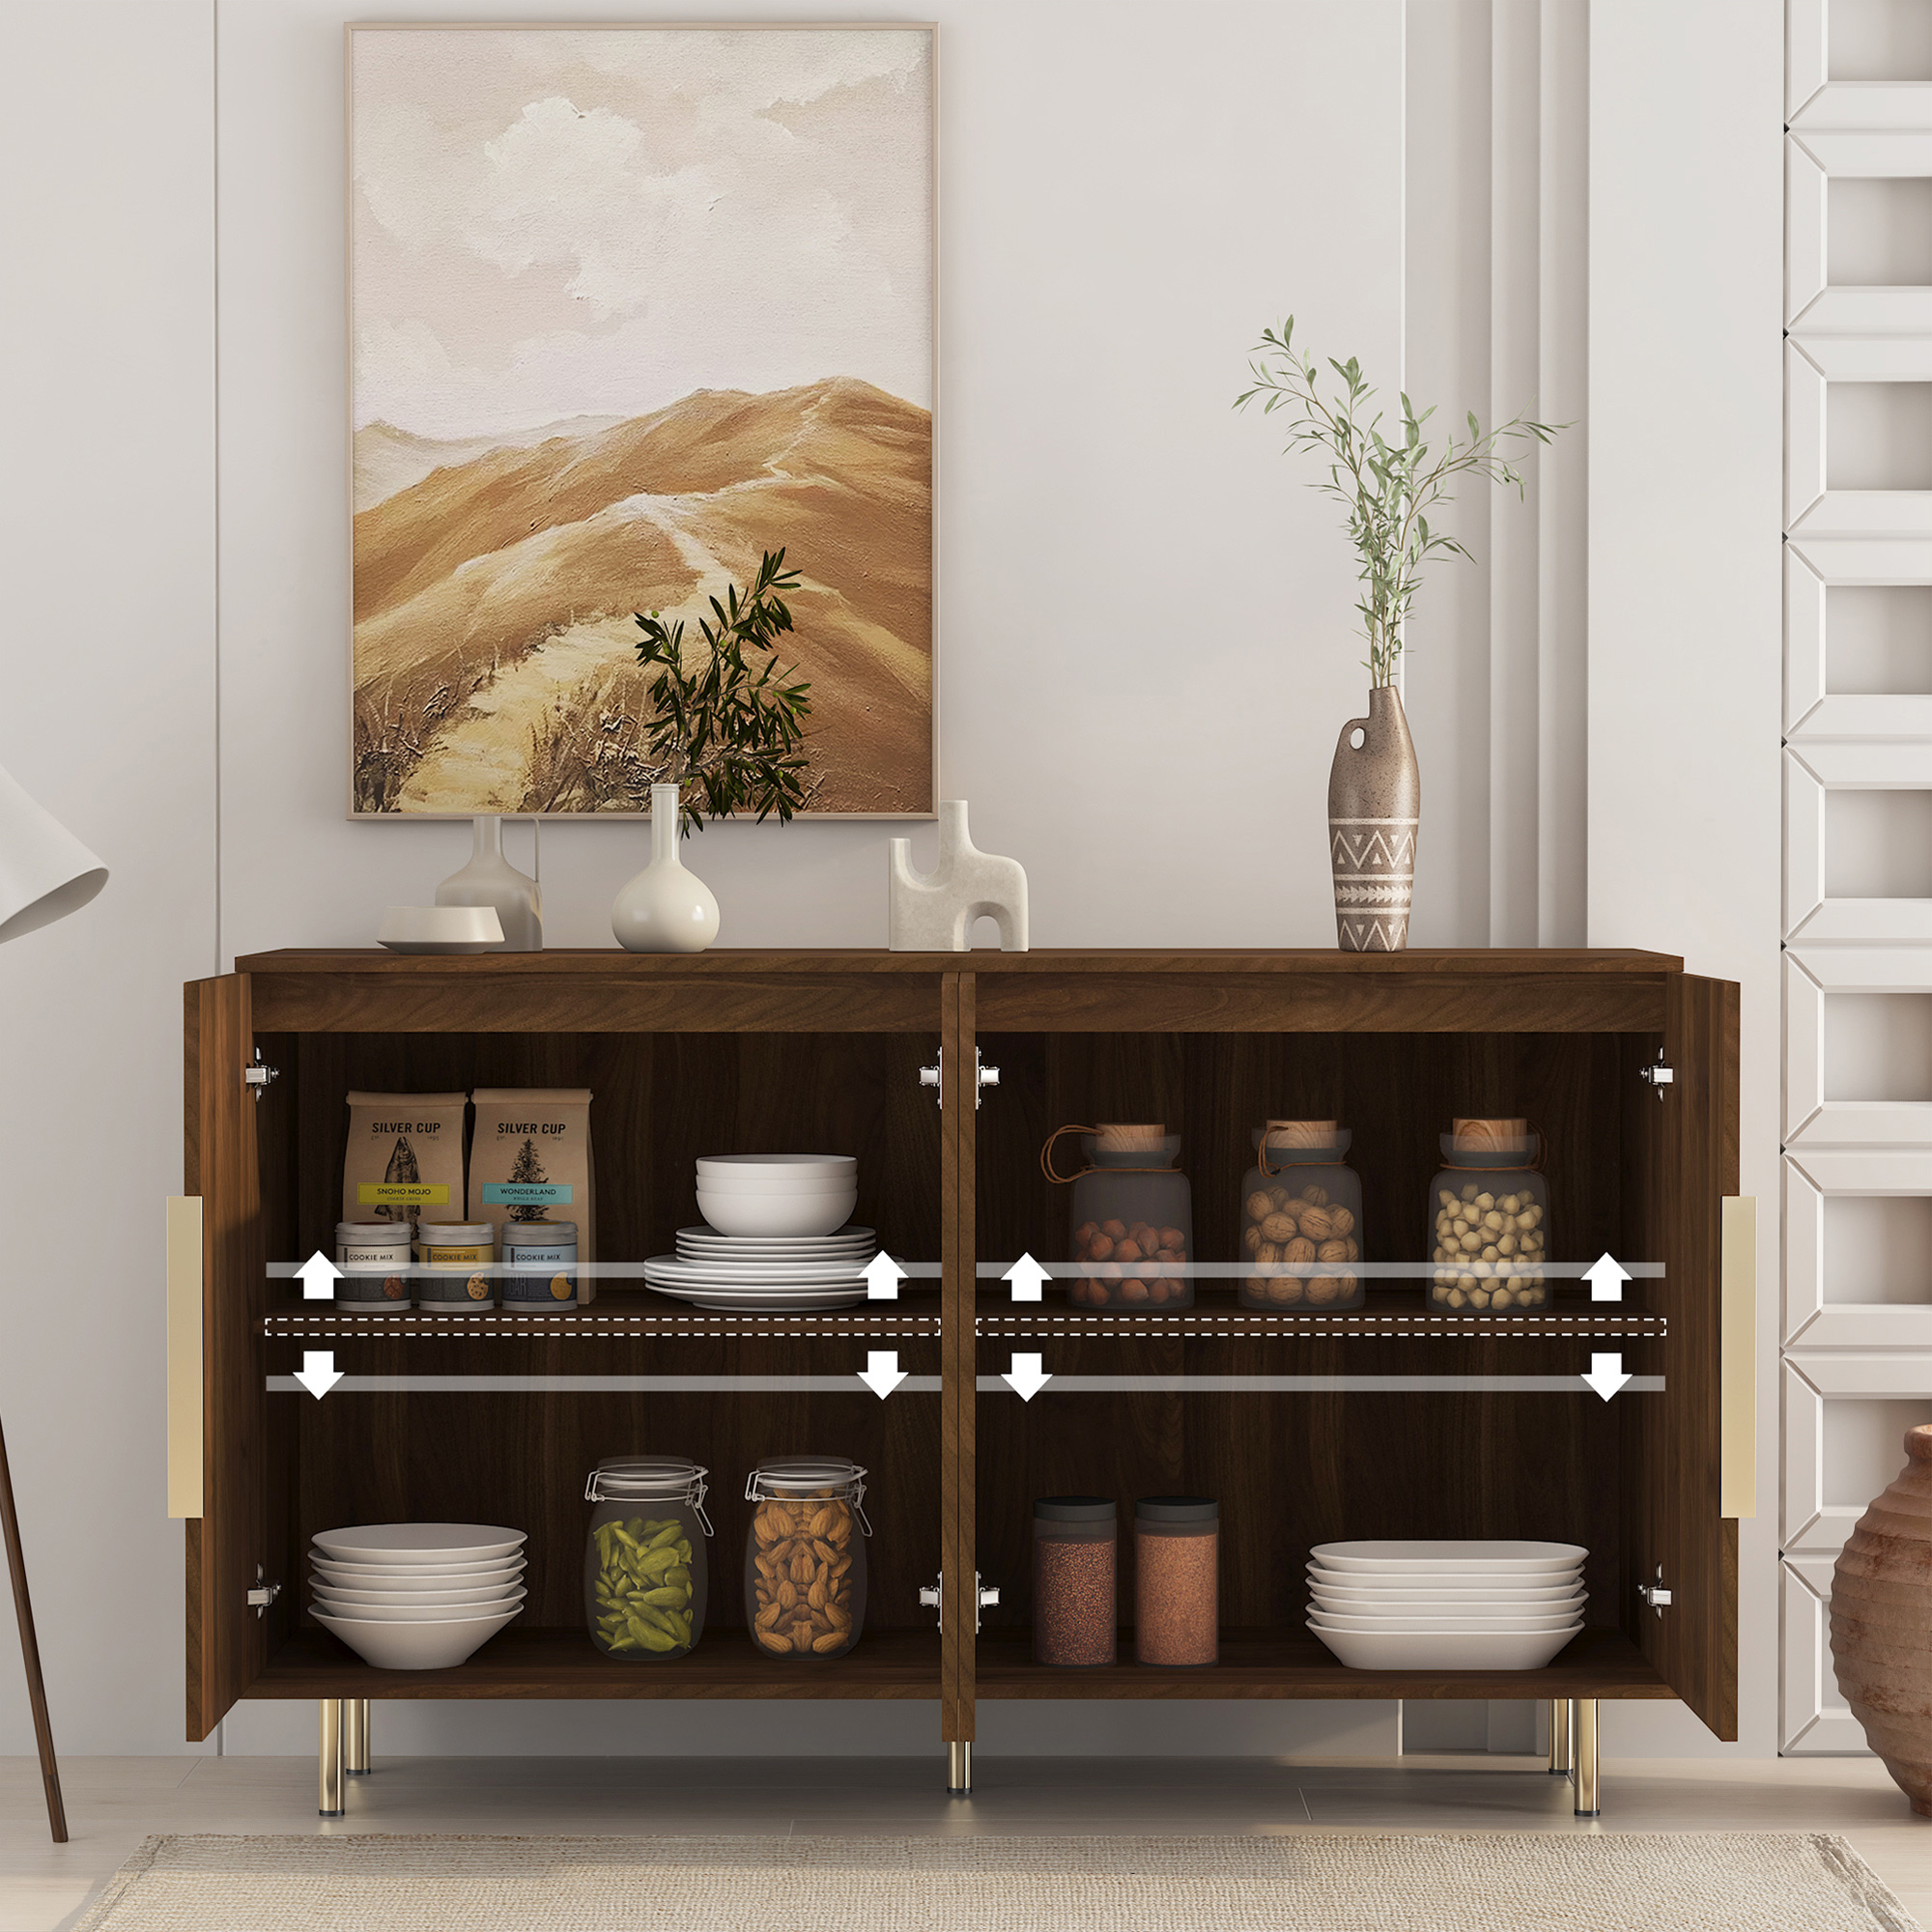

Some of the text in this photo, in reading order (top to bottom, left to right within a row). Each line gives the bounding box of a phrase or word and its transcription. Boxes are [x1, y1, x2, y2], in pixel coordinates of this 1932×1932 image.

[371, 1122, 441, 1133] SILVER CUP
[497, 1122, 566, 1134] SILVER CUP
[408, 1187, 432, 1196] MOJO
[499, 1187, 556, 1196] WONDERLAND
